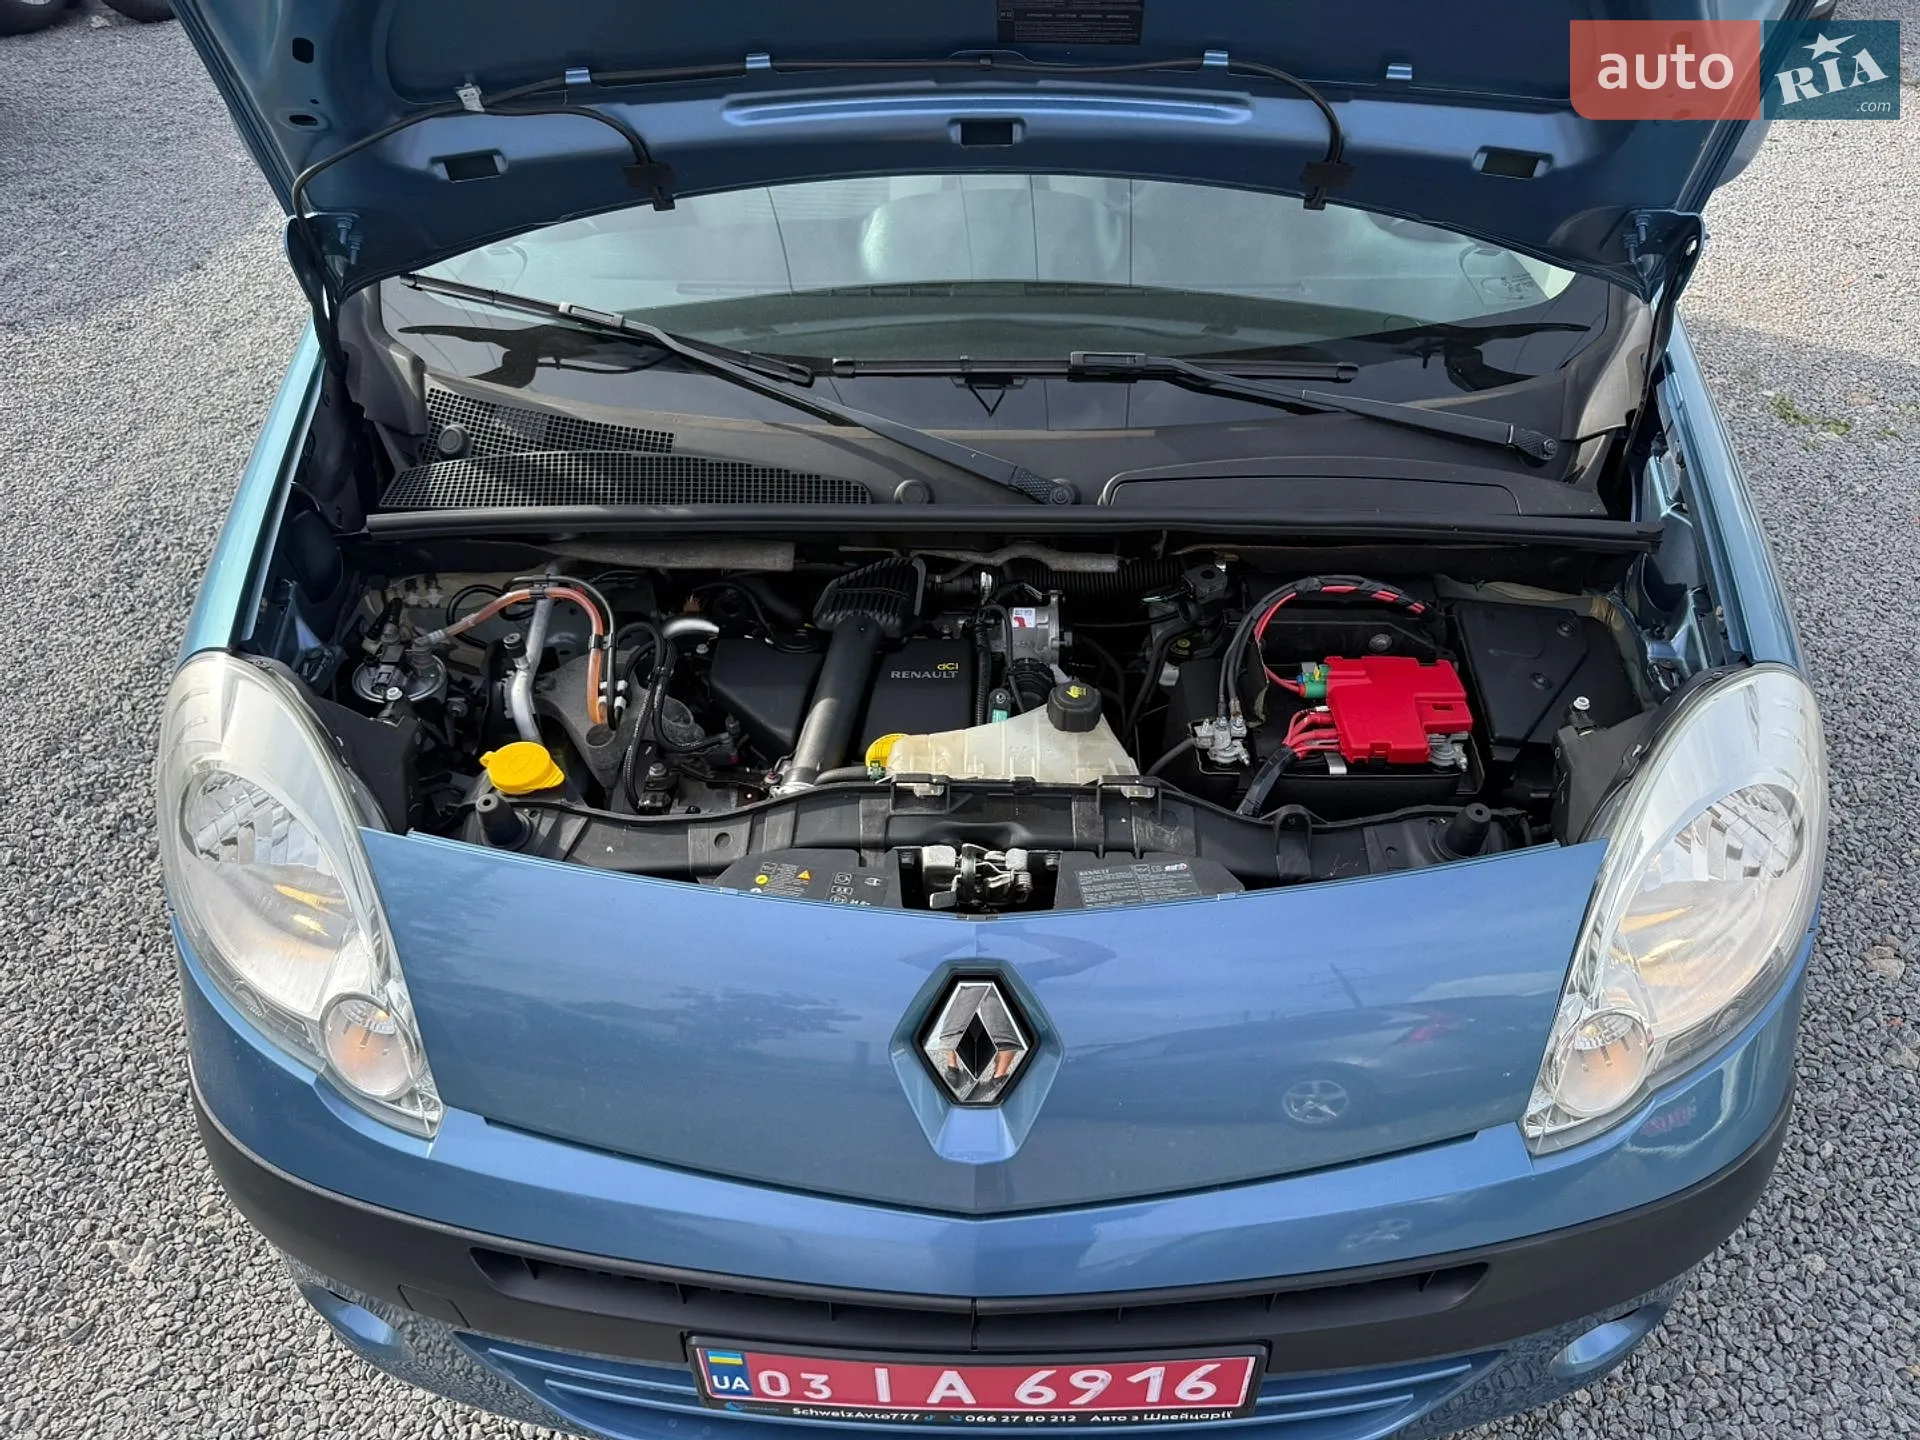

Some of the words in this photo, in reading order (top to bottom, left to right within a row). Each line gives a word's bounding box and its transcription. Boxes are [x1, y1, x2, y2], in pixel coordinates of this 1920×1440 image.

[890, 670, 958, 679] RENAULT
[711, 1374, 750, 1391] UA
[758, 1369, 832, 1400] 03
[1014, 1363, 1221, 1405] 6916
[1050, 1414, 1077, 1423] 212
